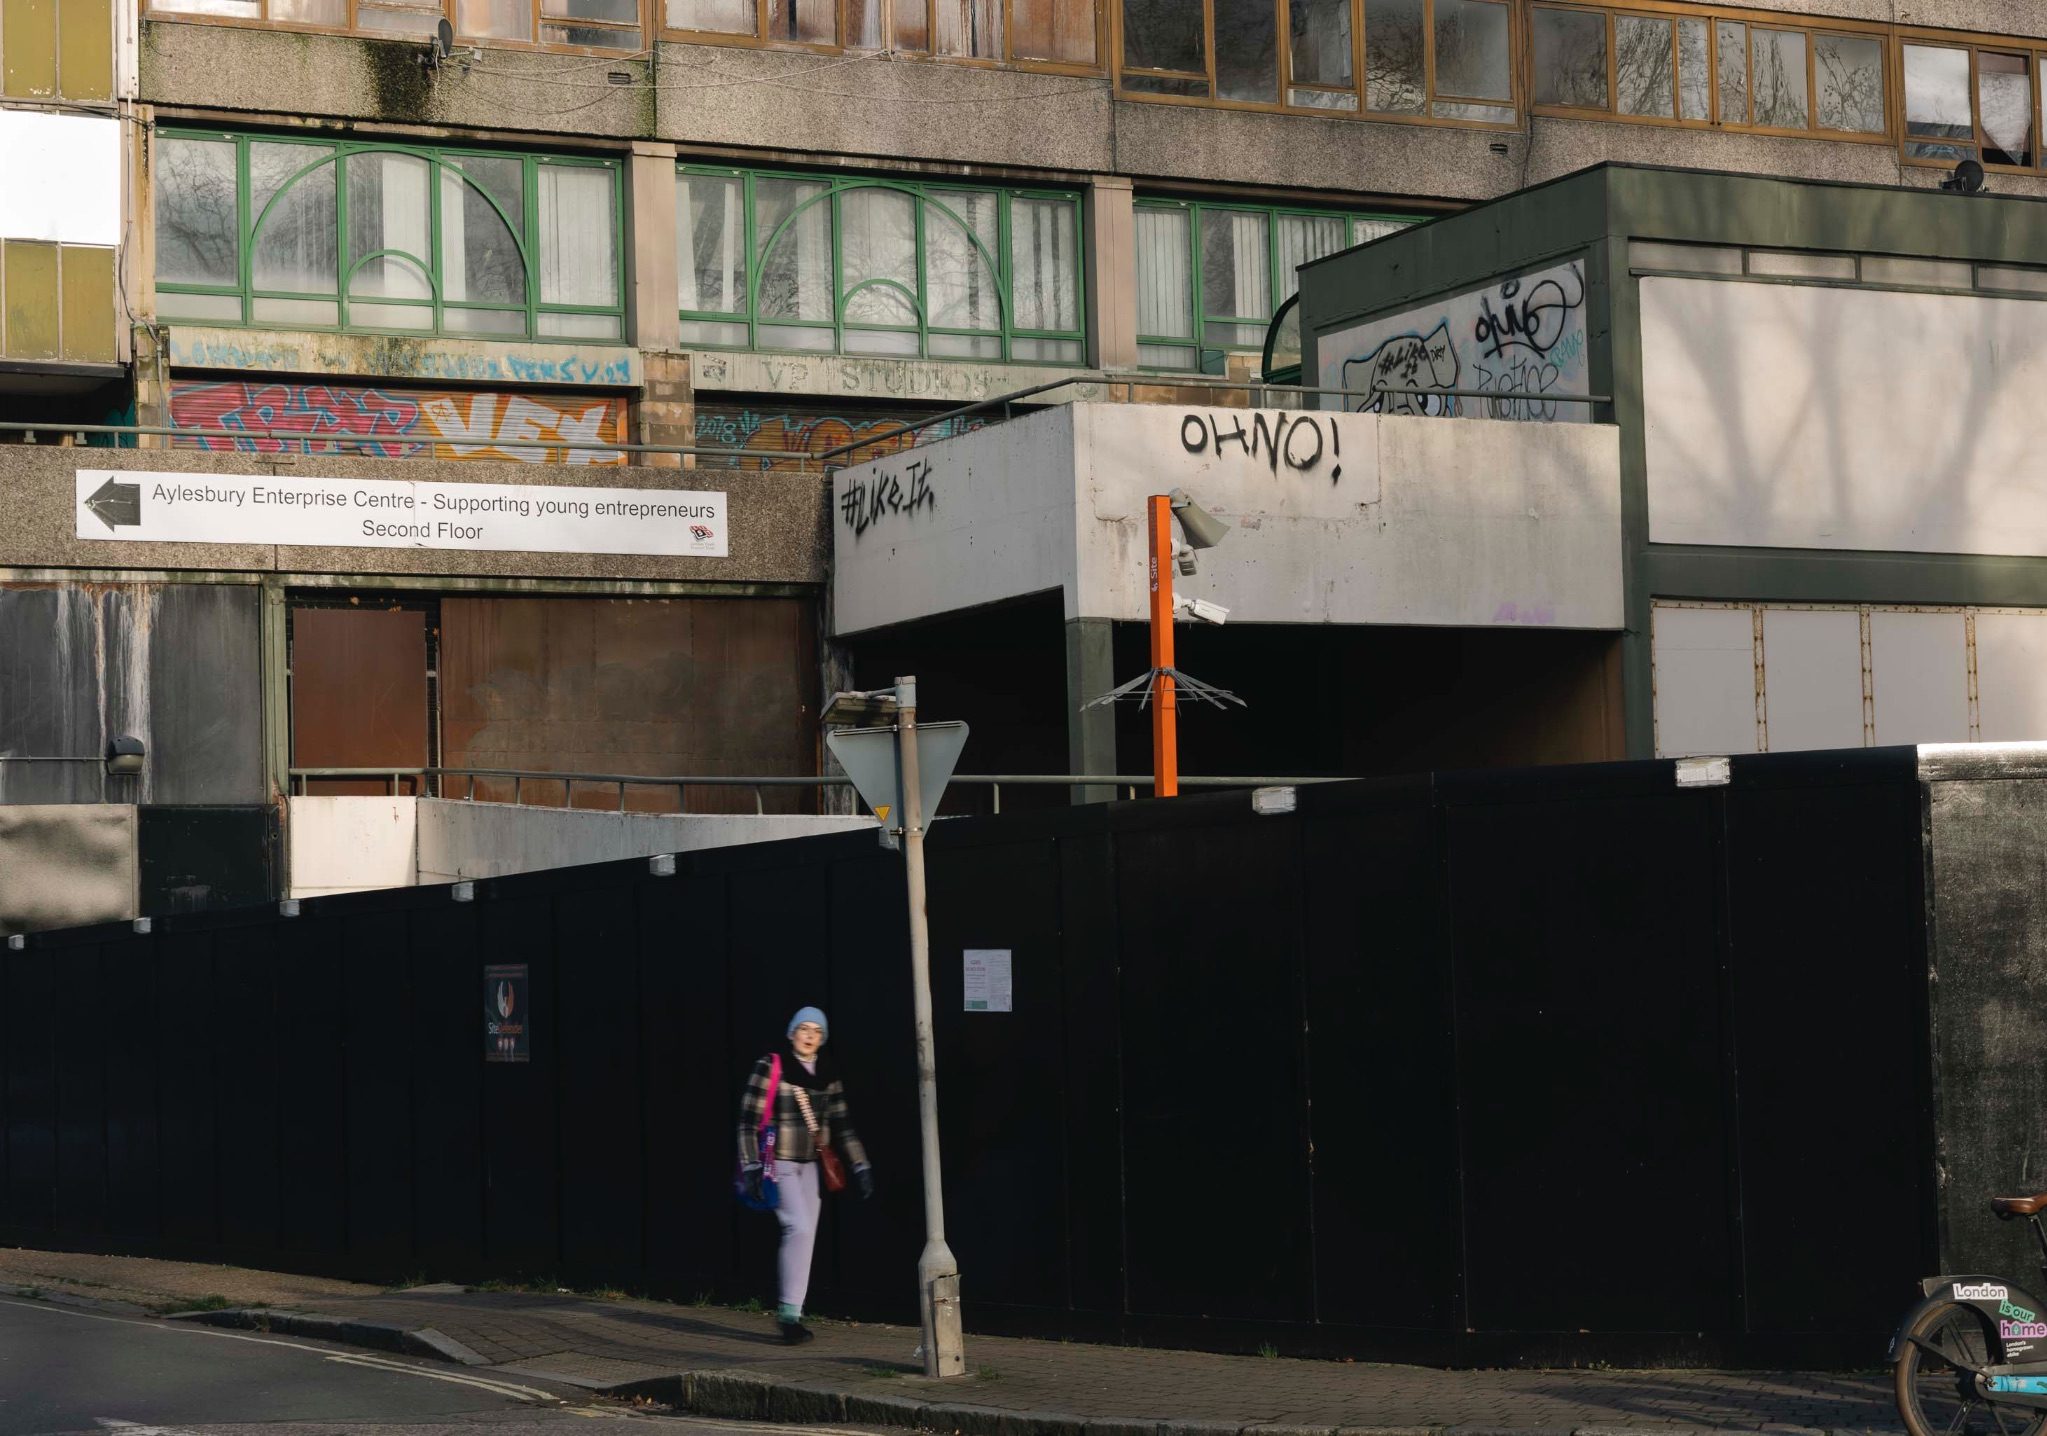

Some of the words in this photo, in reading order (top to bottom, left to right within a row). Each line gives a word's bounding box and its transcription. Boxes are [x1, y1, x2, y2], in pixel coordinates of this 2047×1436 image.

[152, 483, 246, 507] Aylesbury
[252, 486, 348, 509] Enterprise
[353, 490, 415, 509] Centre
[433, 493, 530, 517] Supporting
[535, 500, 590, 519] young
[594, 500, 716, 520] entrepreneurs
[362, 519, 431, 538] Second
[437, 521, 484, 540] Floor
[1955, 1285, 2006, 1298] London
[2001, 1301, 2011, 1314] is
[2013, 1308, 2033, 1322] our
